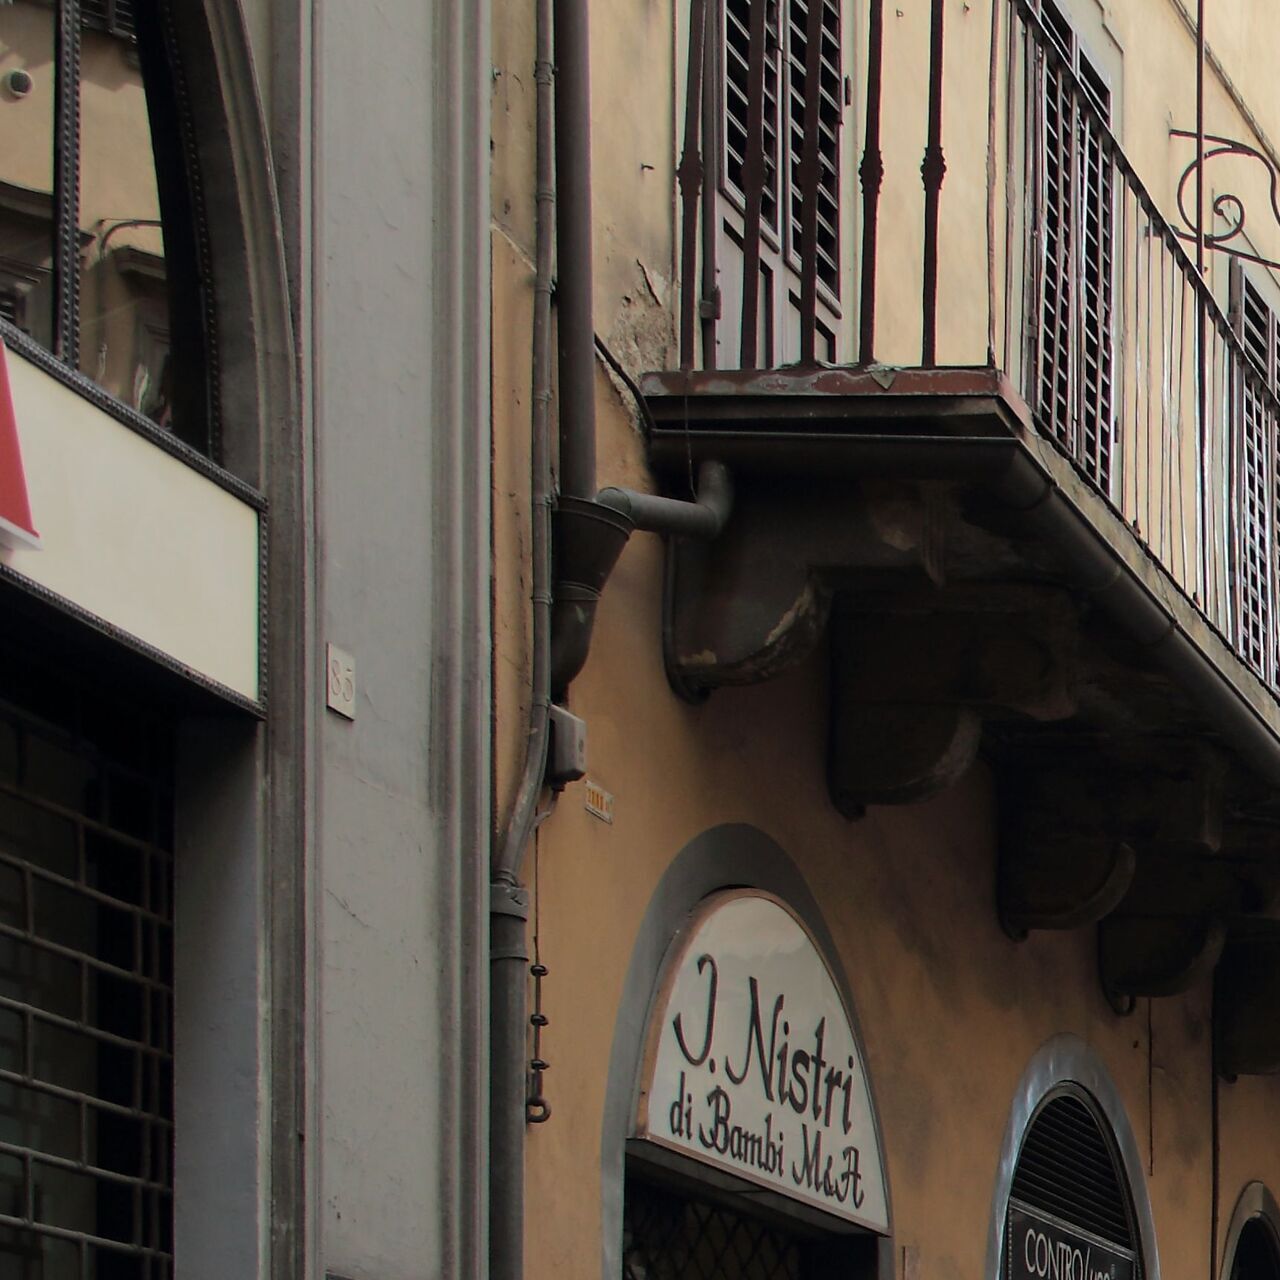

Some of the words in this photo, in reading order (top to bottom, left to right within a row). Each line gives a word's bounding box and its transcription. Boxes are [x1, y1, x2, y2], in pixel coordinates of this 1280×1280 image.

[725, 976, 854, 1135] Nistri
[670, 1071, 693, 1140] di
[699, 1085, 784, 1177] Bambi
